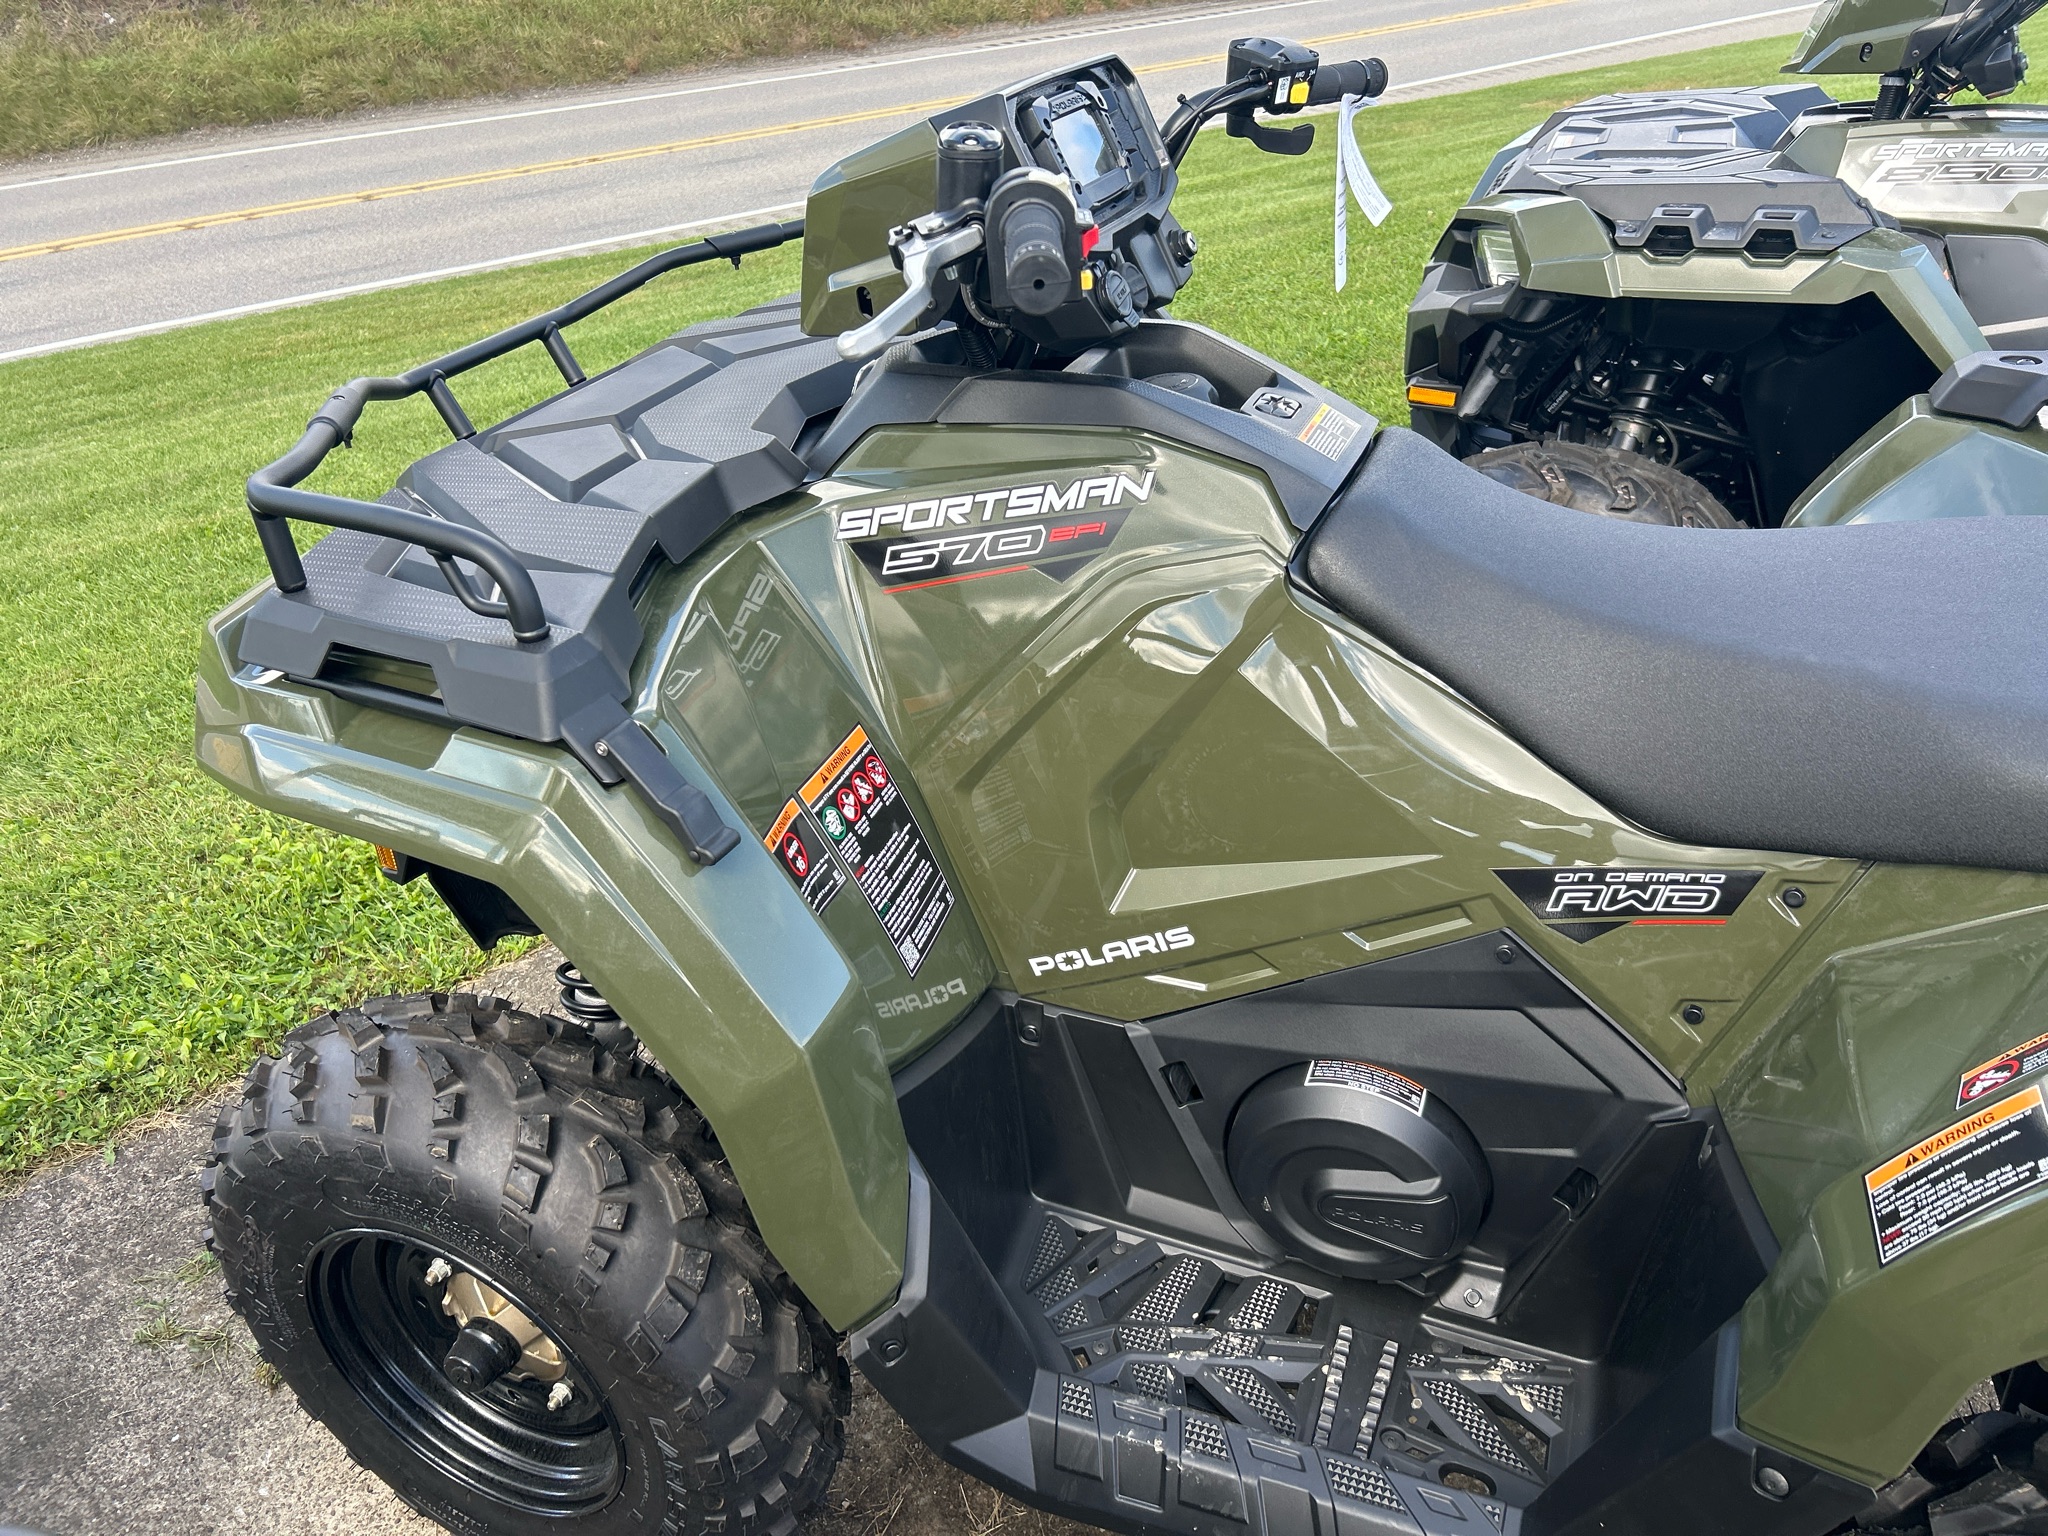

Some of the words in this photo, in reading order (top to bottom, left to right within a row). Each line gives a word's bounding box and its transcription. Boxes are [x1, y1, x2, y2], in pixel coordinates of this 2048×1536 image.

[1872, 142, 2048, 161] SPORTSMA
[836, 471, 1155, 541] SPORTSMAN
[881, 524, 1046, 576] 570
[1048, 521, 1107, 543] EFI
[825, 745, 851, 776] WARNING
[774, 811, 792, 841] WARNING
[1554, 872, 1594, 884] ON
[1605, 872, 1727, 884] DEMAND
[1545, 885, 1722, 912] AWD
[1028, 926, 1195, 977] POLARIS
[1921, 1112, 1996, 1157] WARNING
[1331, 1207, 1424, 1234] POLARIS
